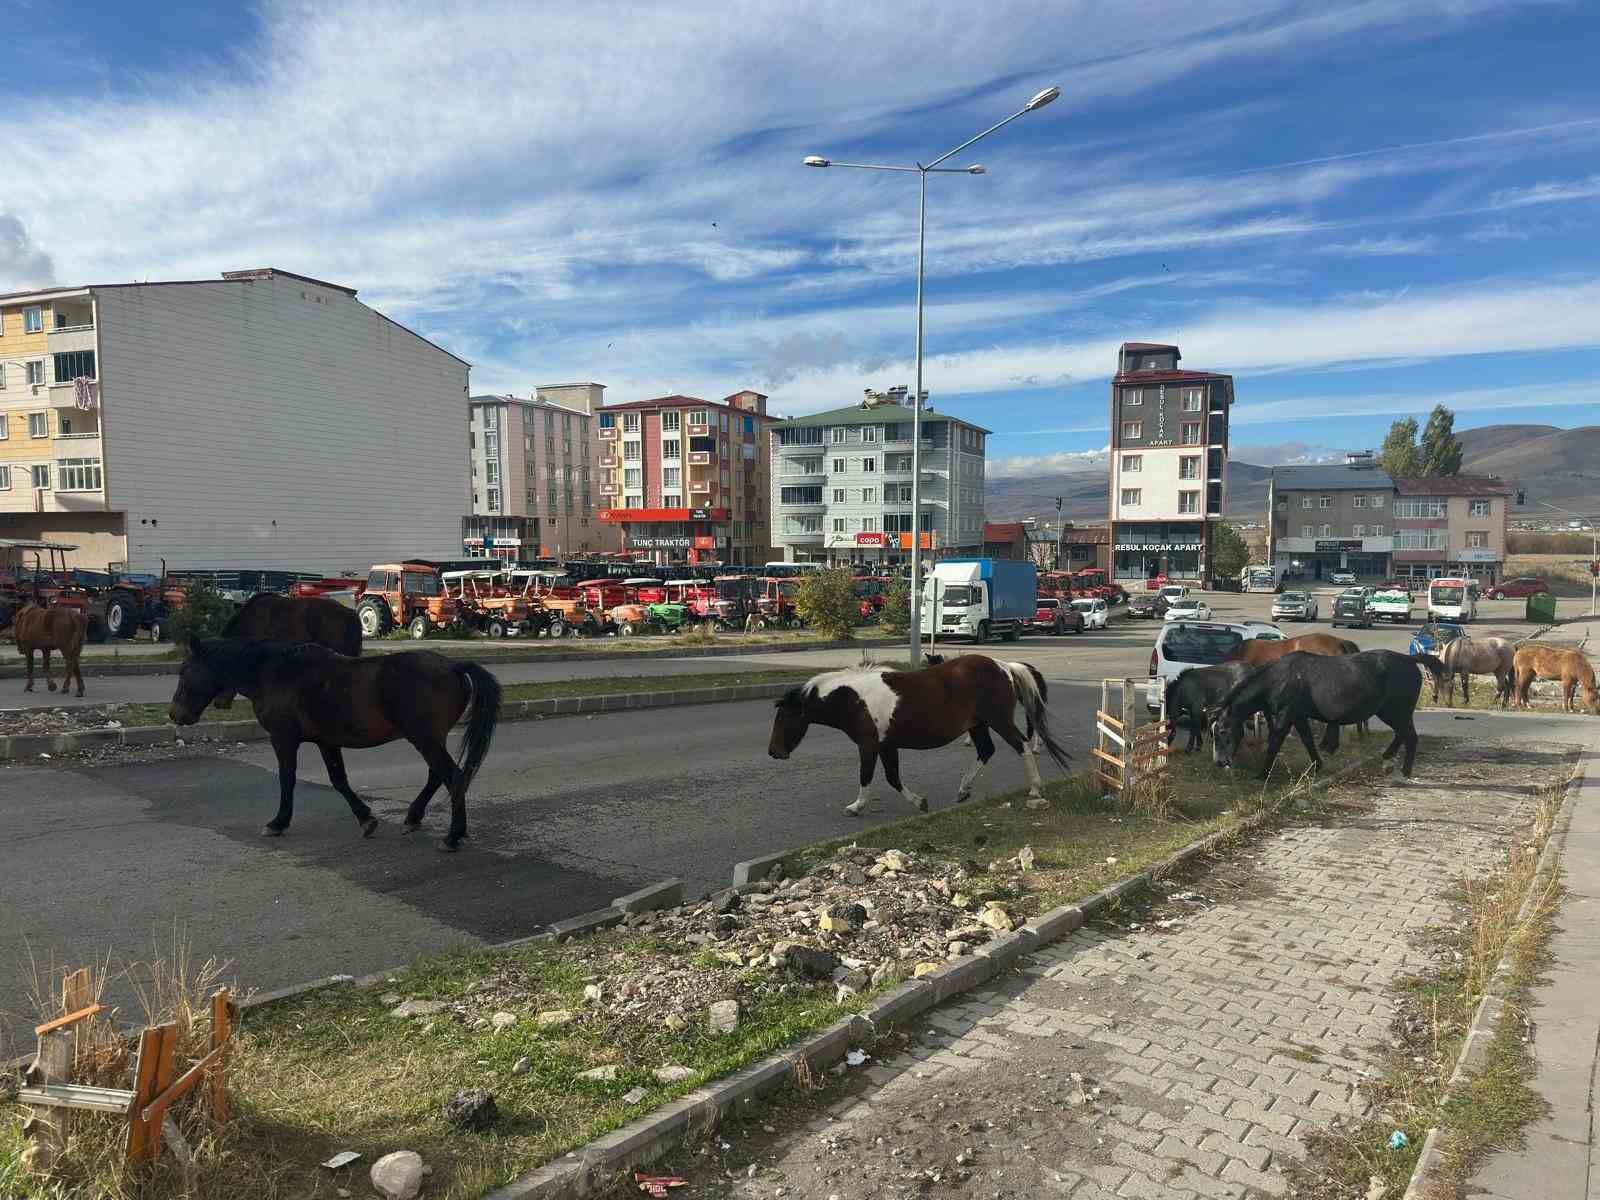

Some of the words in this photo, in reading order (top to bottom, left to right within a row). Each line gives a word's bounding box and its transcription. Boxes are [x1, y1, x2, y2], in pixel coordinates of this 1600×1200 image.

[632, 539, 654, 547] TUNÇ
[655, 538, 690, 546] TRAKTÖR
[1143, 544, 1172, 552] KOÇAK
